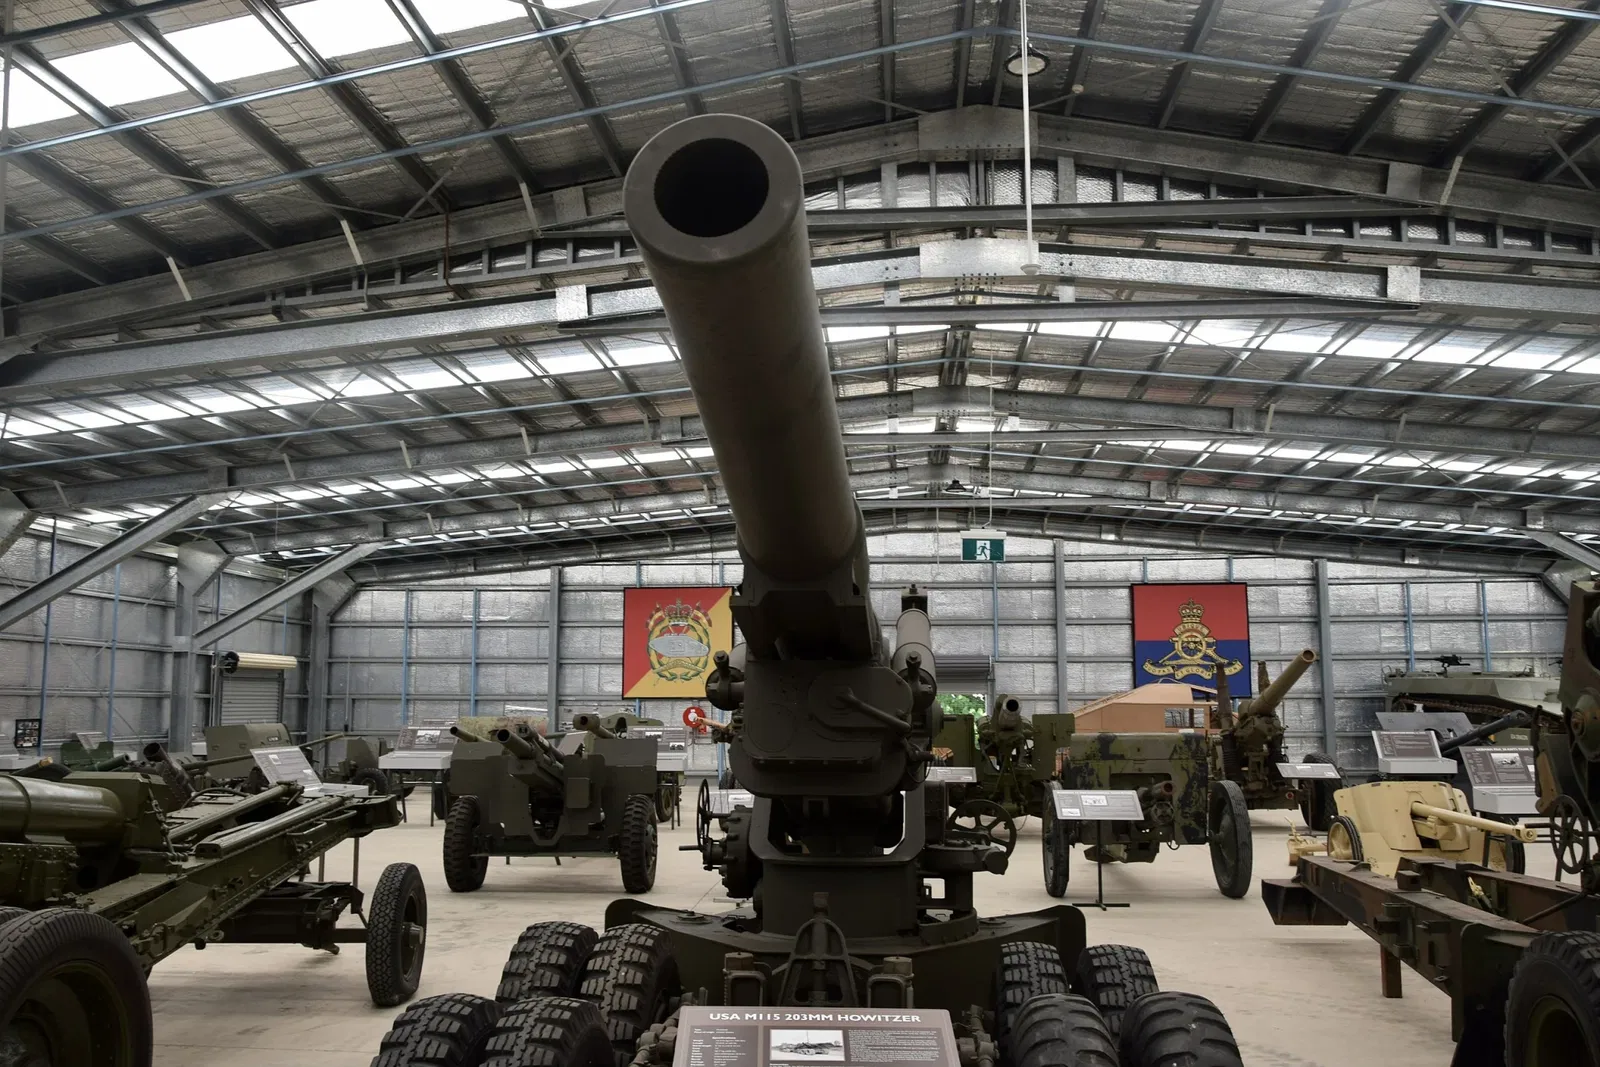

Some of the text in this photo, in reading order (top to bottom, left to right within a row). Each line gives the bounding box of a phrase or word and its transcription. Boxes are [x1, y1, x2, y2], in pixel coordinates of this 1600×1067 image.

[709, 1013, 922, 1023] USA M115 203MM HOWITZER
